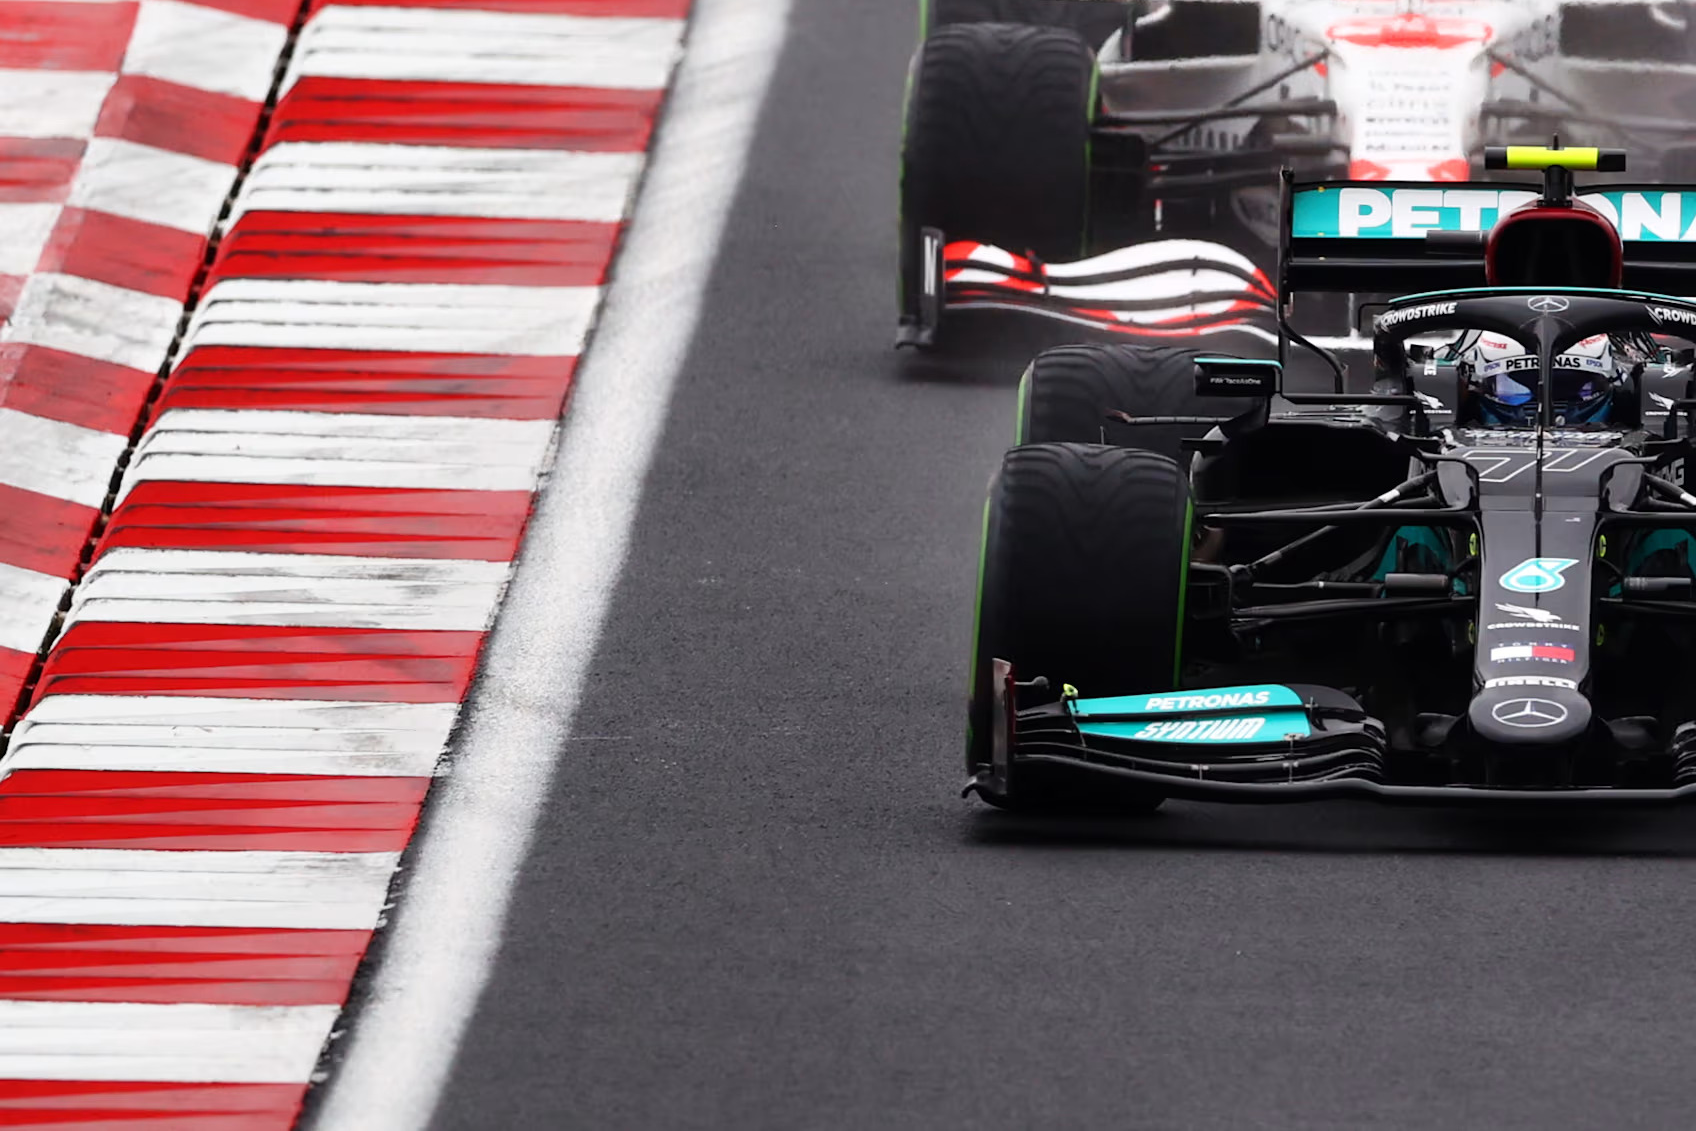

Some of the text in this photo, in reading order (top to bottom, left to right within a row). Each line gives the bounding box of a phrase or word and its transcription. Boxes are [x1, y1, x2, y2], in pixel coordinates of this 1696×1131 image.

[1381, 302, 1458, 331] CROWDSTRIKE
[1506, 356, 1581, 370] PETRNAS
[1487, 622, 1580, 631] CROWDSTRIKE
[1485, 675, 1577, 690] PIRELLI
[1145, 690, 1271, 711] PETRONAS
[1135, 717, 1267, 739] SYNTIUM
